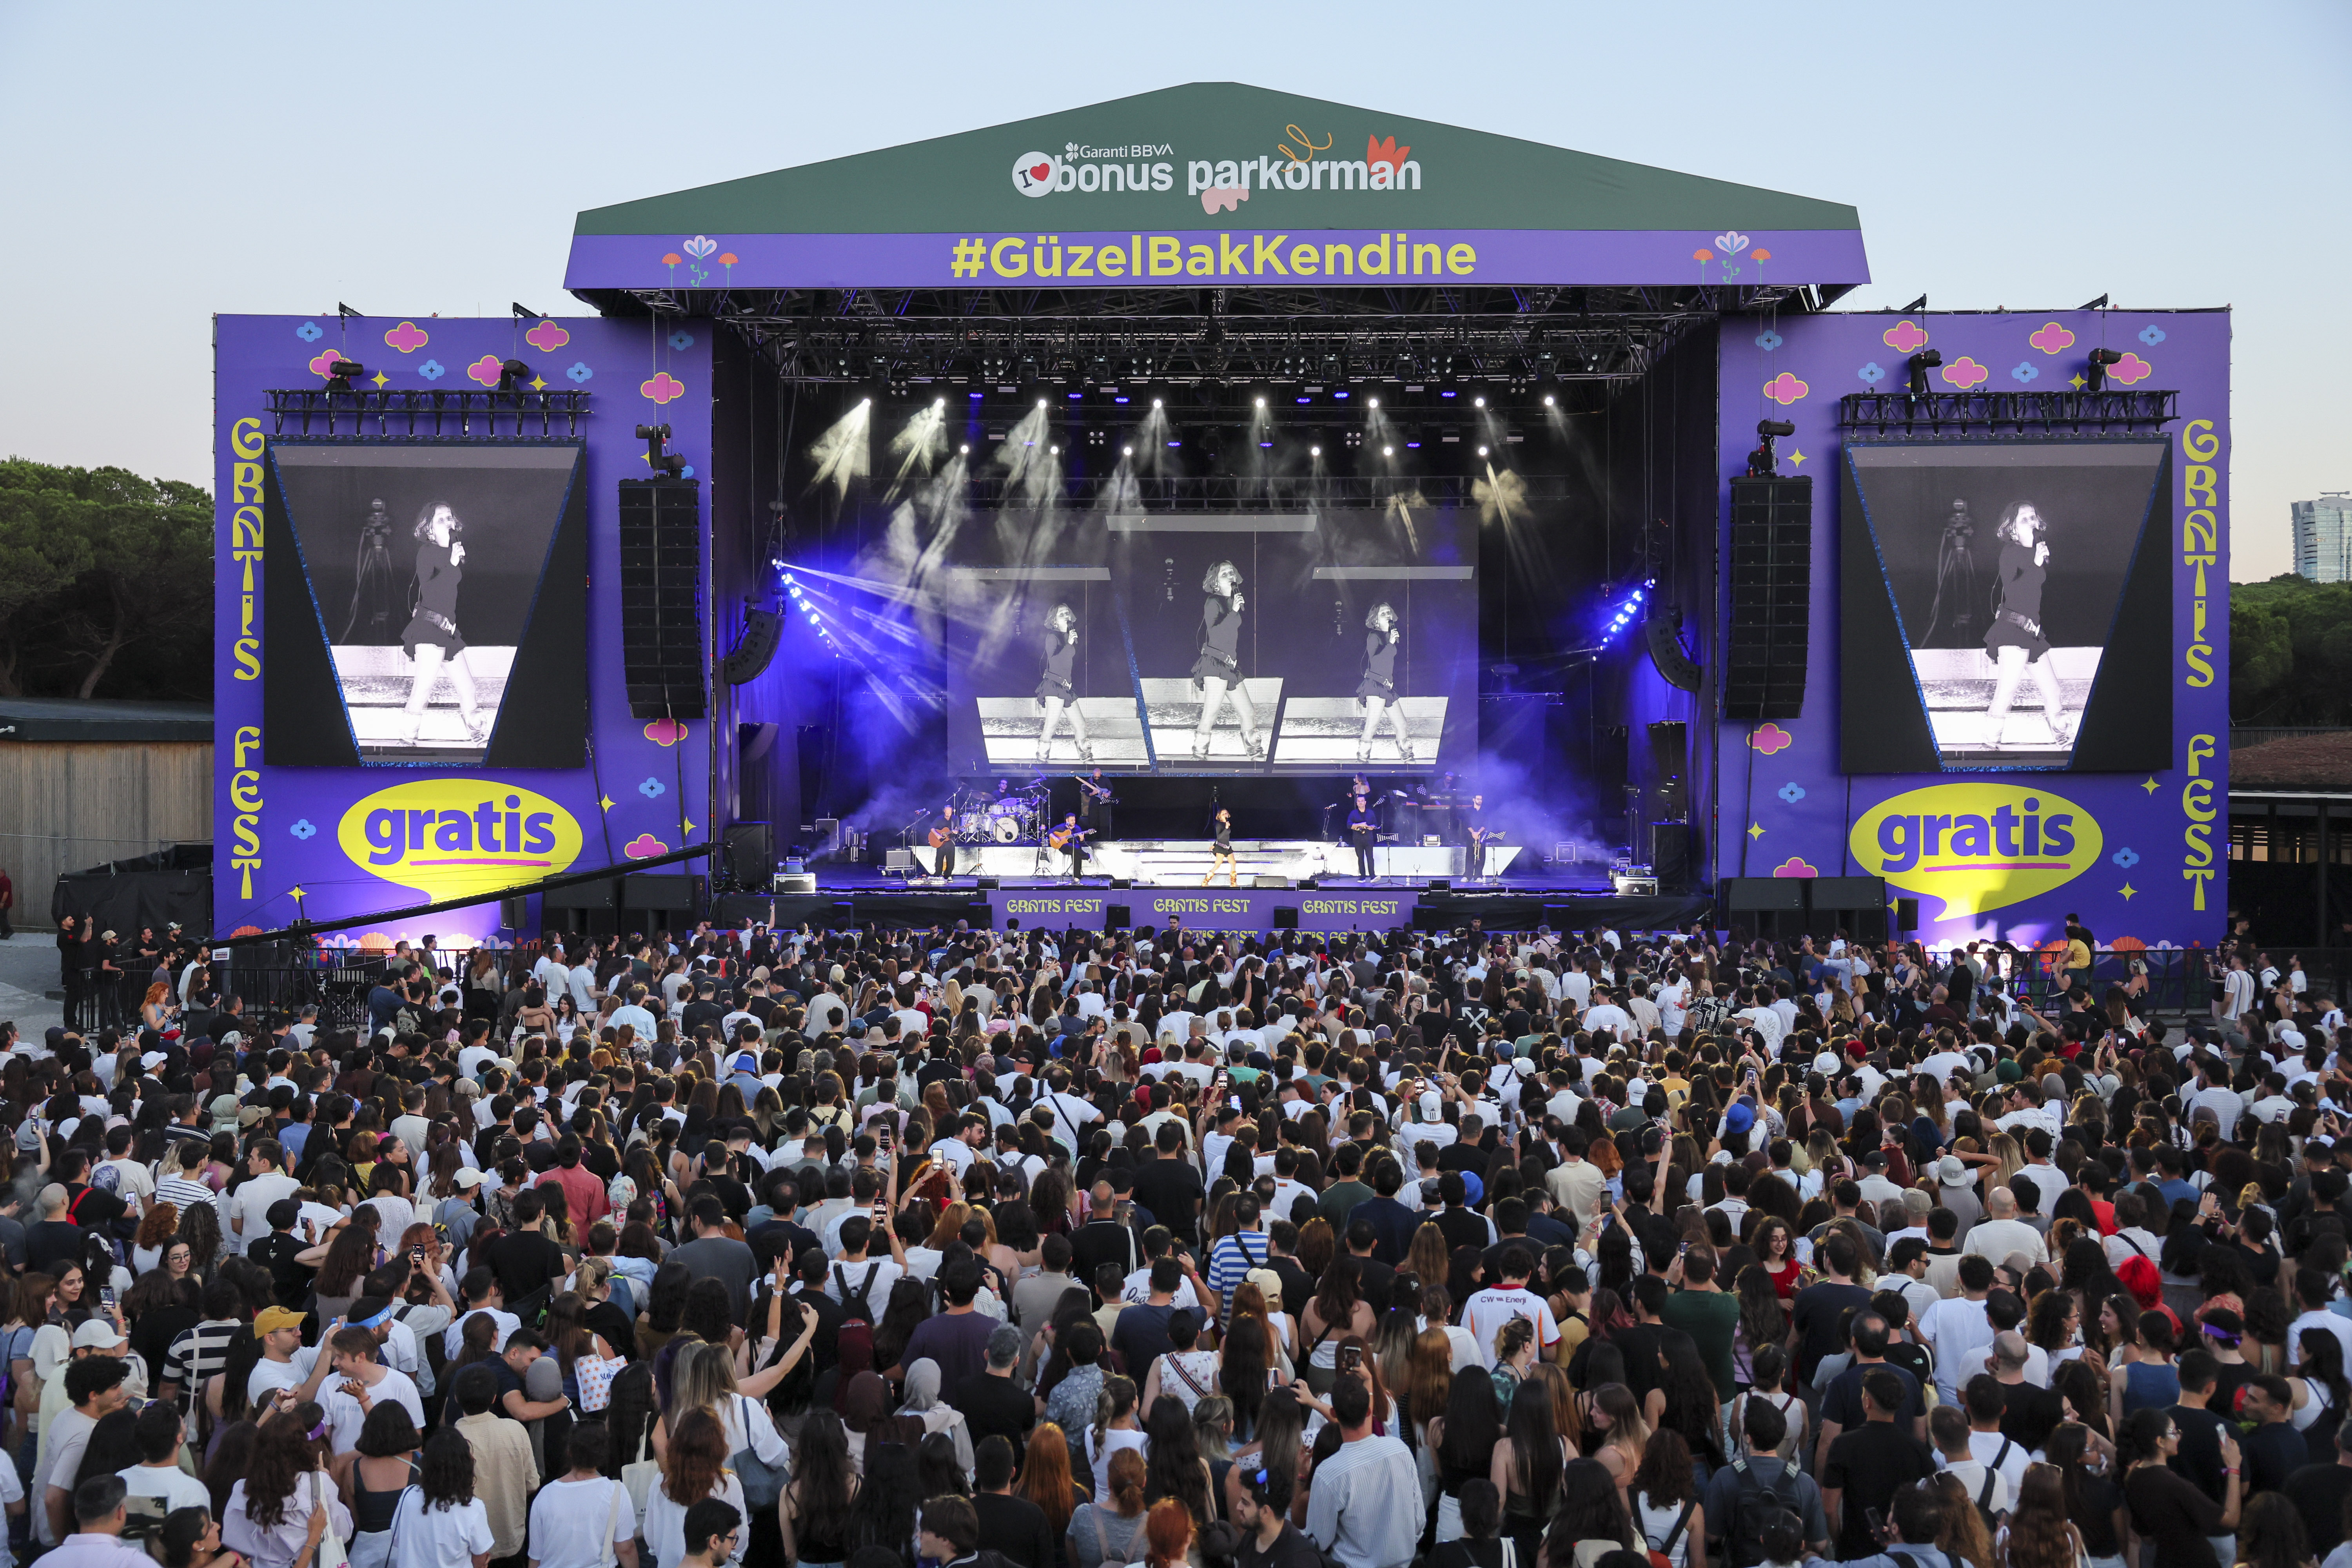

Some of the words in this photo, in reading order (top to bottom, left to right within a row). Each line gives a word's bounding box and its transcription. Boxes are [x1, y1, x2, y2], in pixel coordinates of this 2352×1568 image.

[1080, 145, 1128, 158] Garanti
[1131, 143, 1174, 157] BBVA
[1054, 155, 1174, 192] bonus
[1188, 156, 1421, 196] parkorman
[951, 233, 1476, 278] #GüzelBakKendine
[232, 417, 265, 681] GRATIS
[2183, 419, 2219, 688] GRATIS
[230, 726, 263, 900] FEST
[365, 795, 555, 865] gratis
[1878, 797, 2075, 872] gratis
[2182, 734, 2217, 911] FEST
[1007, 899, 1061, 913] GRATIS
[1065, 899, 1102, 913] FEST
[1154, 899, 1209, 913] GRATIS
[1213, 899, 1250, 913] FEST
[1303, 900, 1357, 914] GRATIS
[1361, 900, 1398, 914] FEST
[378, 1309, 390, 1323] MOR
[1506, 1296, 1526, 1305] Enerji
